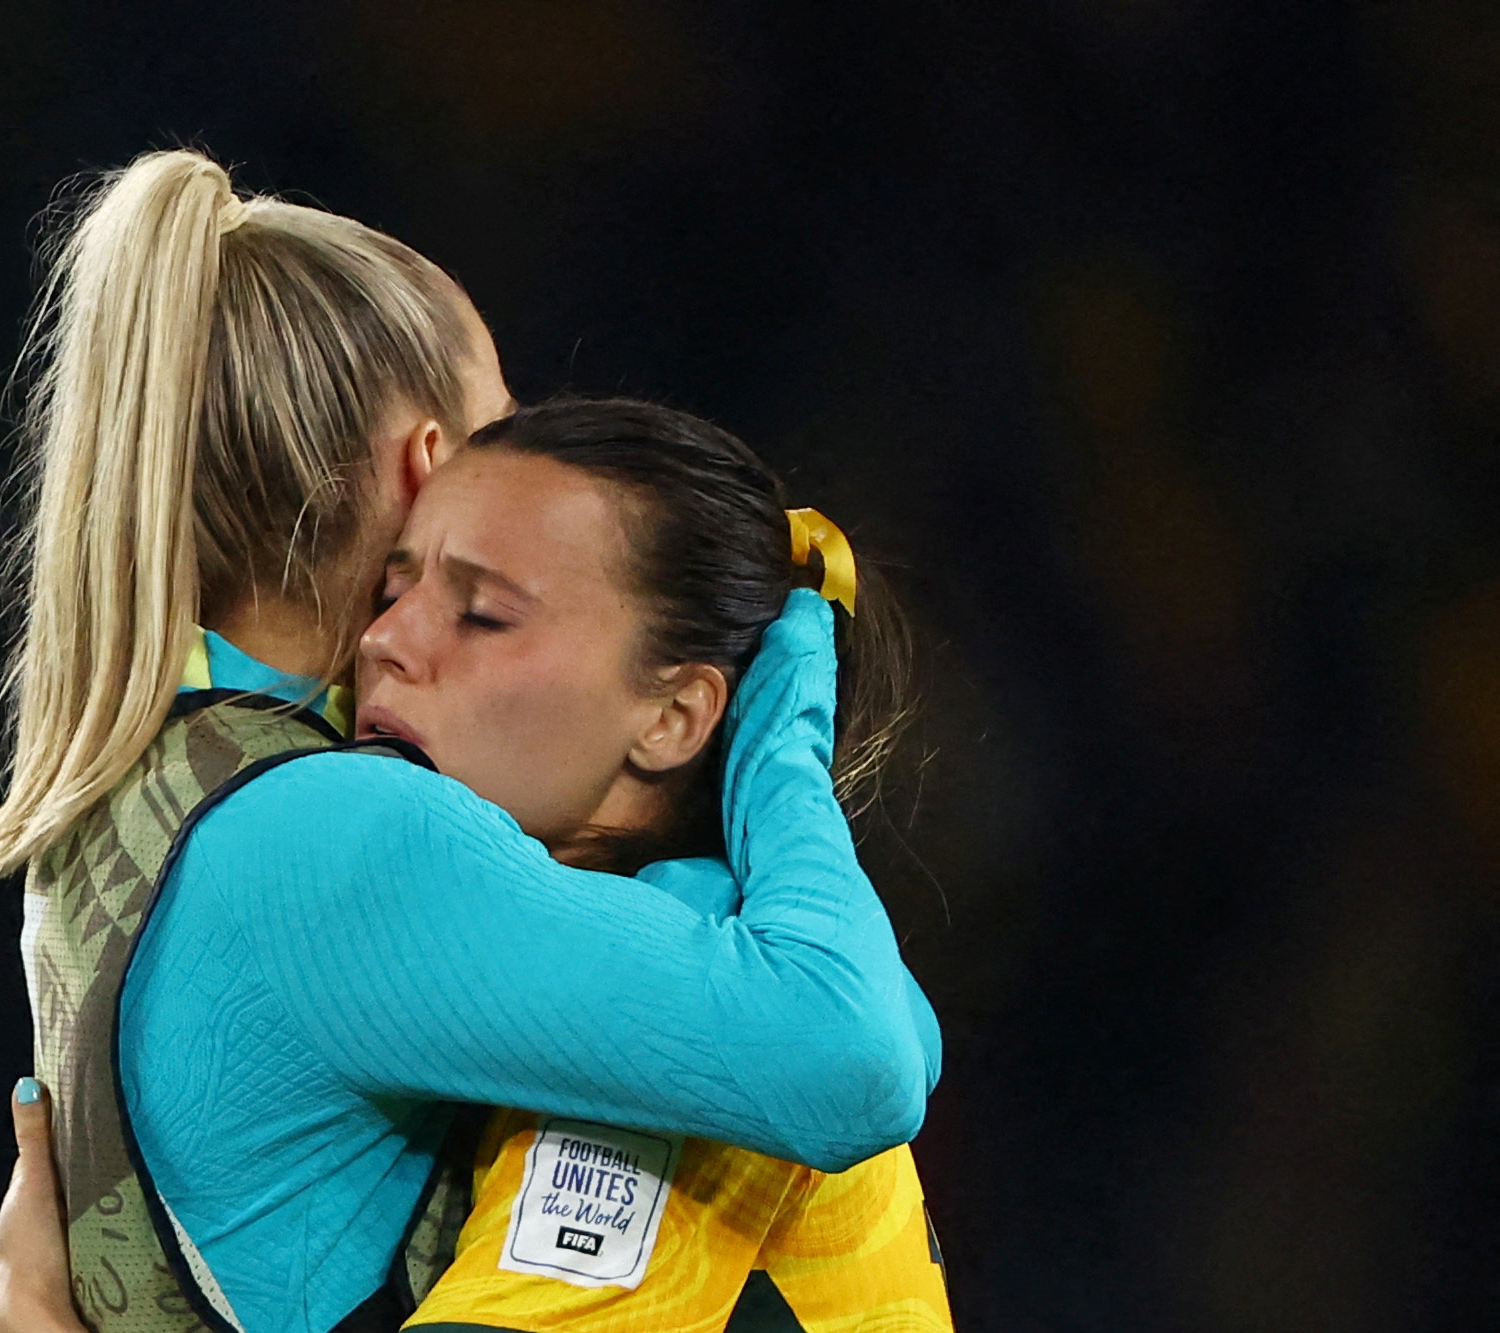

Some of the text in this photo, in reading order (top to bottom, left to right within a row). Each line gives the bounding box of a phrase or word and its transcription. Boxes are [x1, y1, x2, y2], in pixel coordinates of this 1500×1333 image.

[557, 1137, 642, 1176] FOOTBALL
[551, 1160, 638, 1206] UNITES
[541, 1192, 636, 1235] the World
[561, 1231, 597, 1252] FIFA
